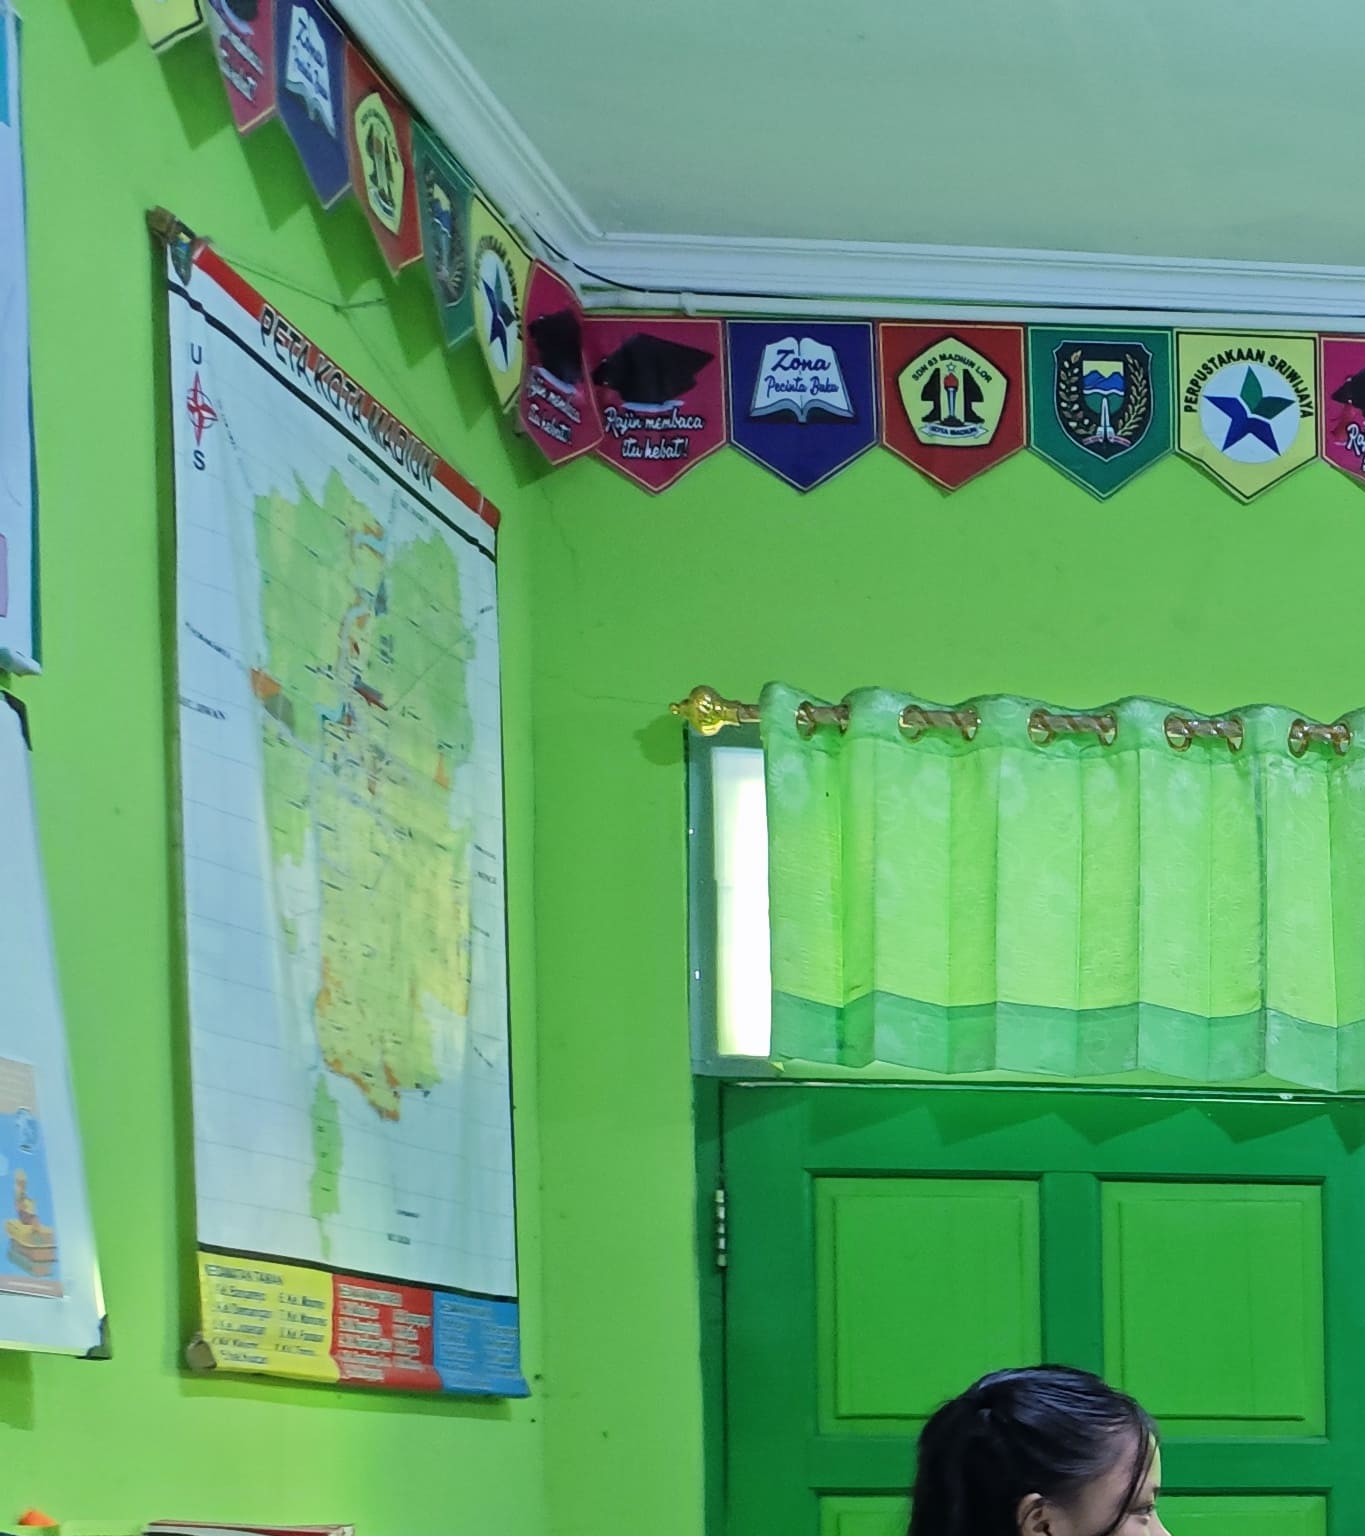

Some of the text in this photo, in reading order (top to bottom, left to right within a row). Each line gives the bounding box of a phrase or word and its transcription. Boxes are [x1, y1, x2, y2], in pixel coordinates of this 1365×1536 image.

[190, 343, 202, 365] U
[260, 303, 312, 387] PETA
[771, 349, 831, 372] Zona
[764, 375, 839, 397] Pecinta Buku
[1184, 347, 1313, 419] PERPUSTAKAAN SRIWIJAYA
[603, 406, 704, 438] Rajin membaca
[622, 438, 689, 459] itu hebat!
[193, 450, 206, 471] S
